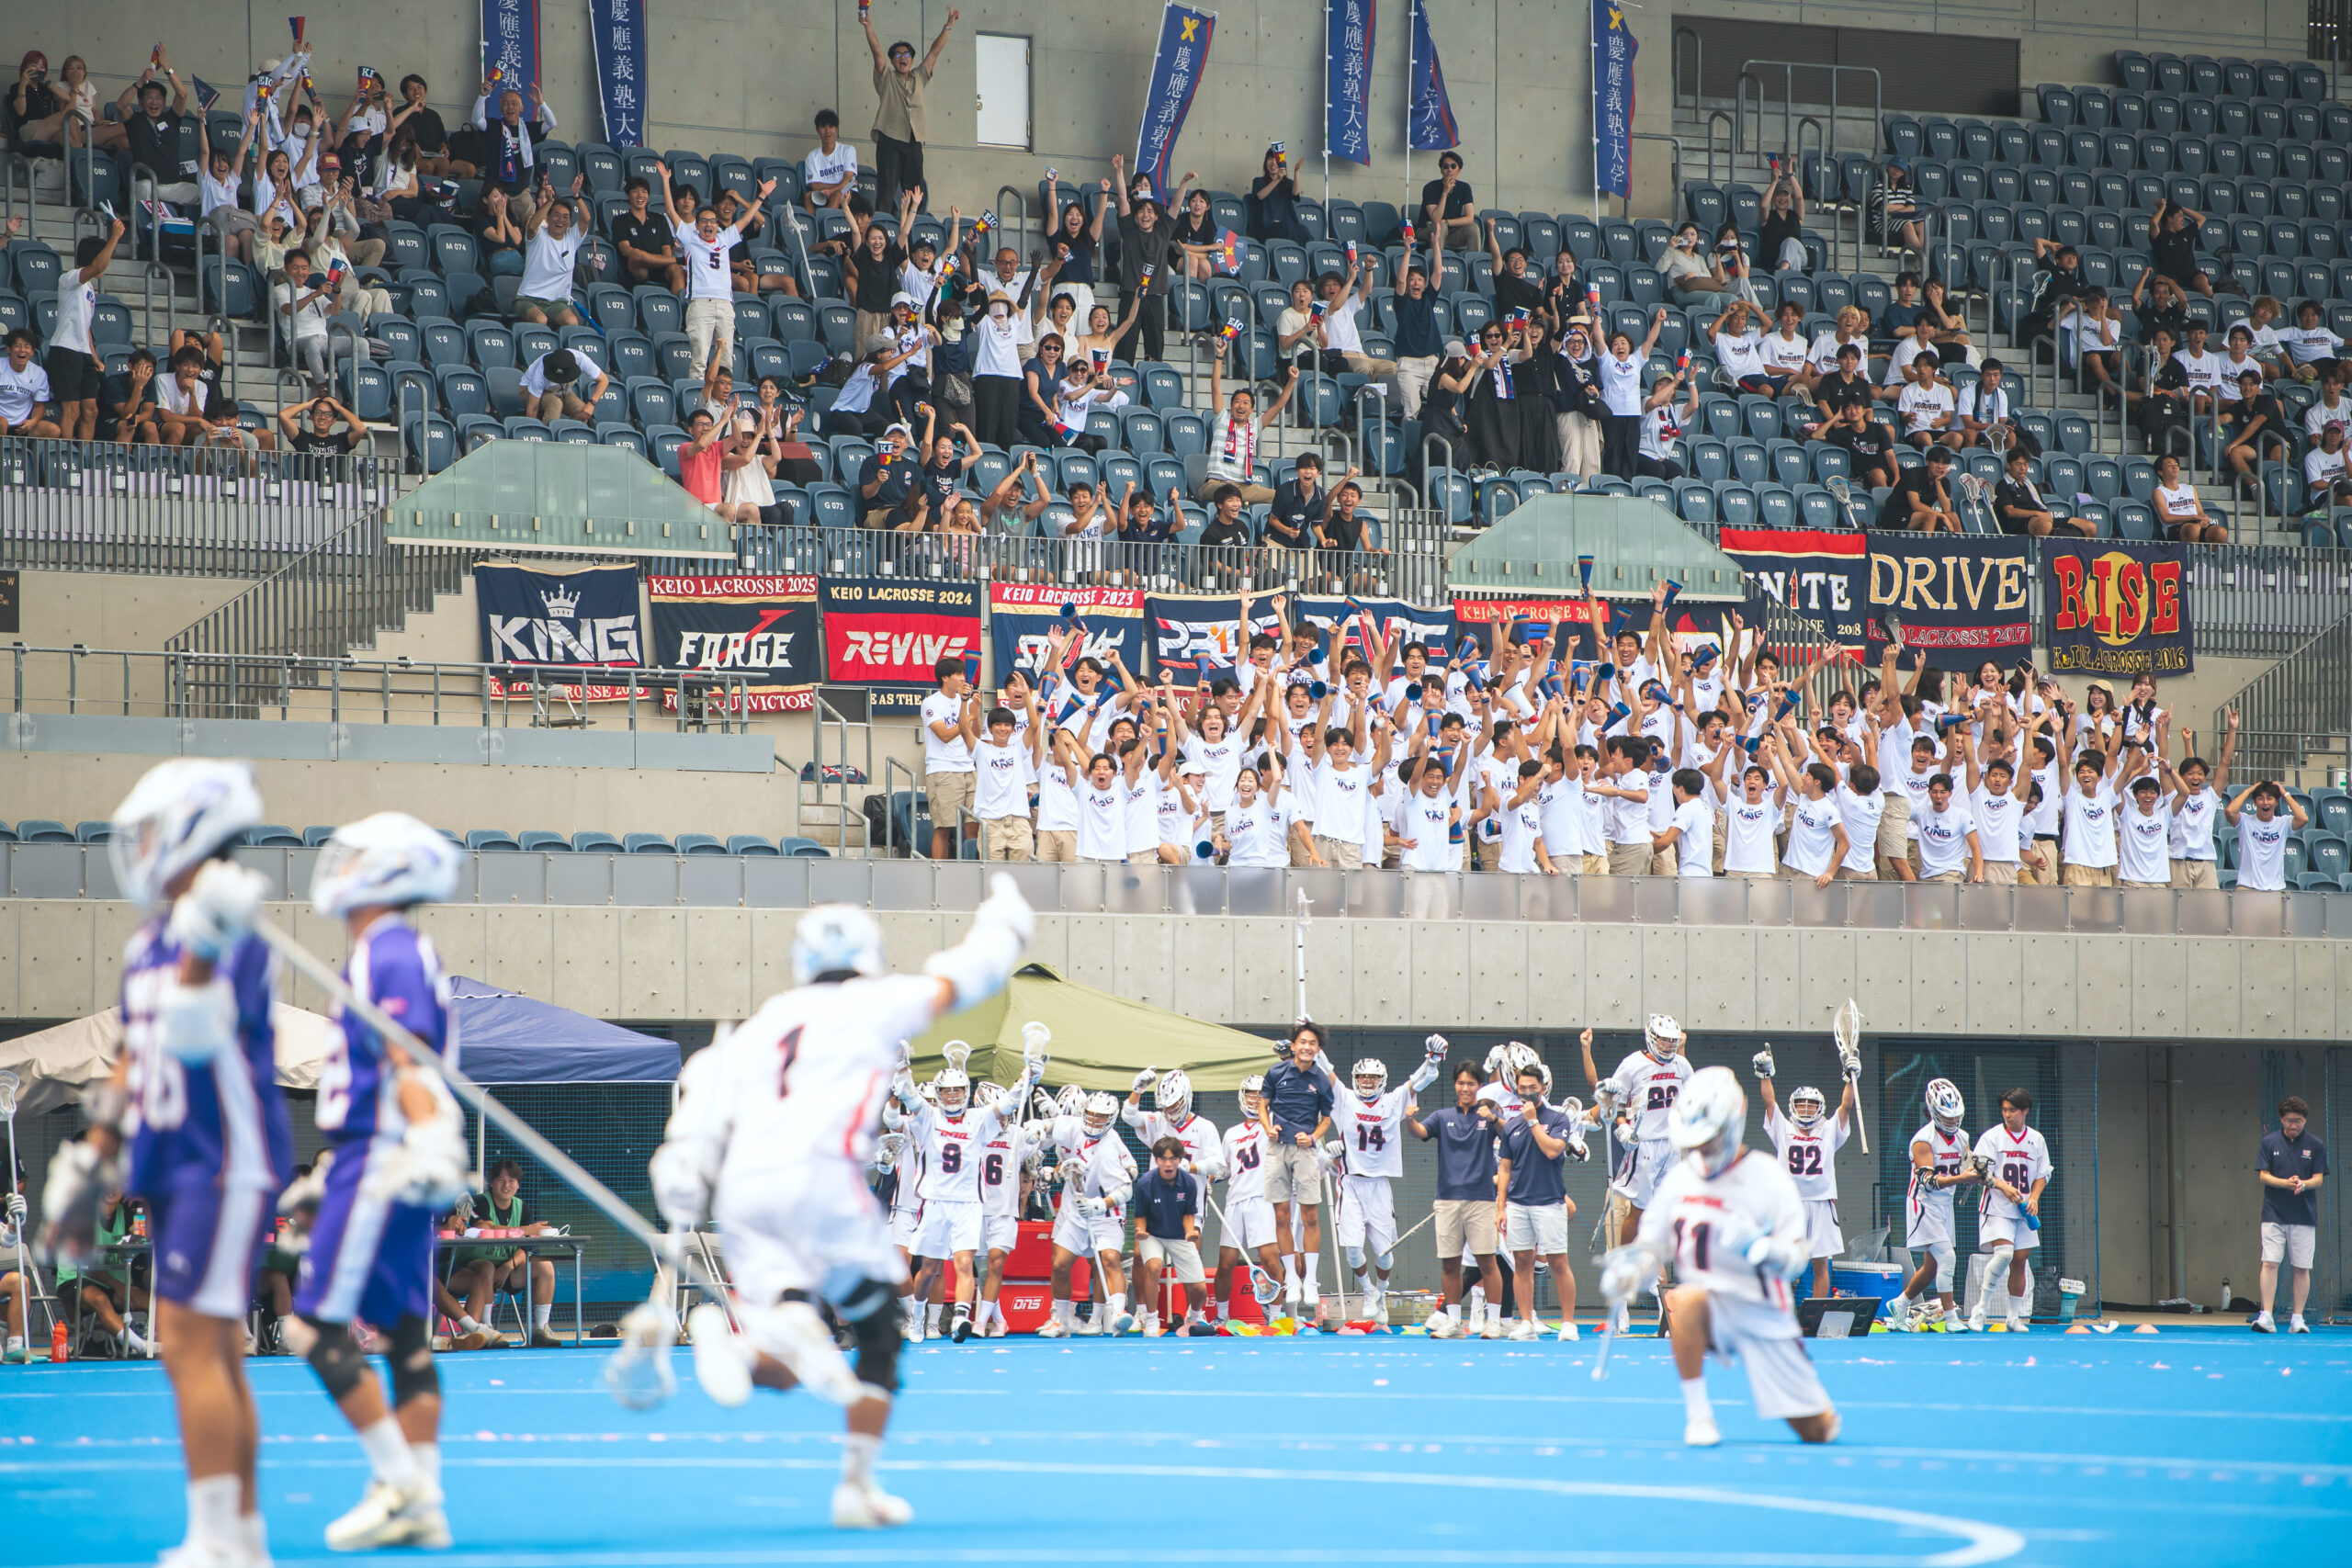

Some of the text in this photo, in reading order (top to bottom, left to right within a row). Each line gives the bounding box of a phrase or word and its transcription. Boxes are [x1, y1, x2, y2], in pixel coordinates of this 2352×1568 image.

[1344, 0, 1363, 155] 慶應義塾大学
[1606, 35, 1626, 187] 慶應義塾大学
[709, 252, 721, 270] 5
[651, 576, 817, 596] KEIO LACROSSE 2025
[831, 586, 973, 605] KEIO LACROSSE 2024
[1002, 586, 1134, 606] KEIO LACROSSE 2023
[1745, 566, 1851, 612] NITE
[1869, 552, 2027, 611] DRIVE
[2053, 555, 2182, 637] RISE
[1463, 605, 1499, 621] KEI
[488, 614, 641, 665] KING
[1837, 623, 1862, 637] 2018
[1908, 627, 1990, 647] LACROSSE
[1993, 626, 2027, 643] 2017
[675, 631, 795, 669] FORGE
[842, 630, 969, 666] REVIVE
[1014, 627, 1125, 679] STIKE
[2154, 646, 2188, 671] 2016
[747, 693, 814, 712] VICTOR
[878, 694, 894, 705] AS
[896, 694, 922, 705] THE
[776, 1024, 807, 1100] 1
[1356, 1122, 1387, 1153] 14
[942, 1142, 963, 1174] 9
[985, 1153, 1004, 1187] 6
[1787, 1144, 1824, 1176] 92
[2002, 1162, 2031, 1195] 99
[1674, 1217, 1711, 1272] 11
